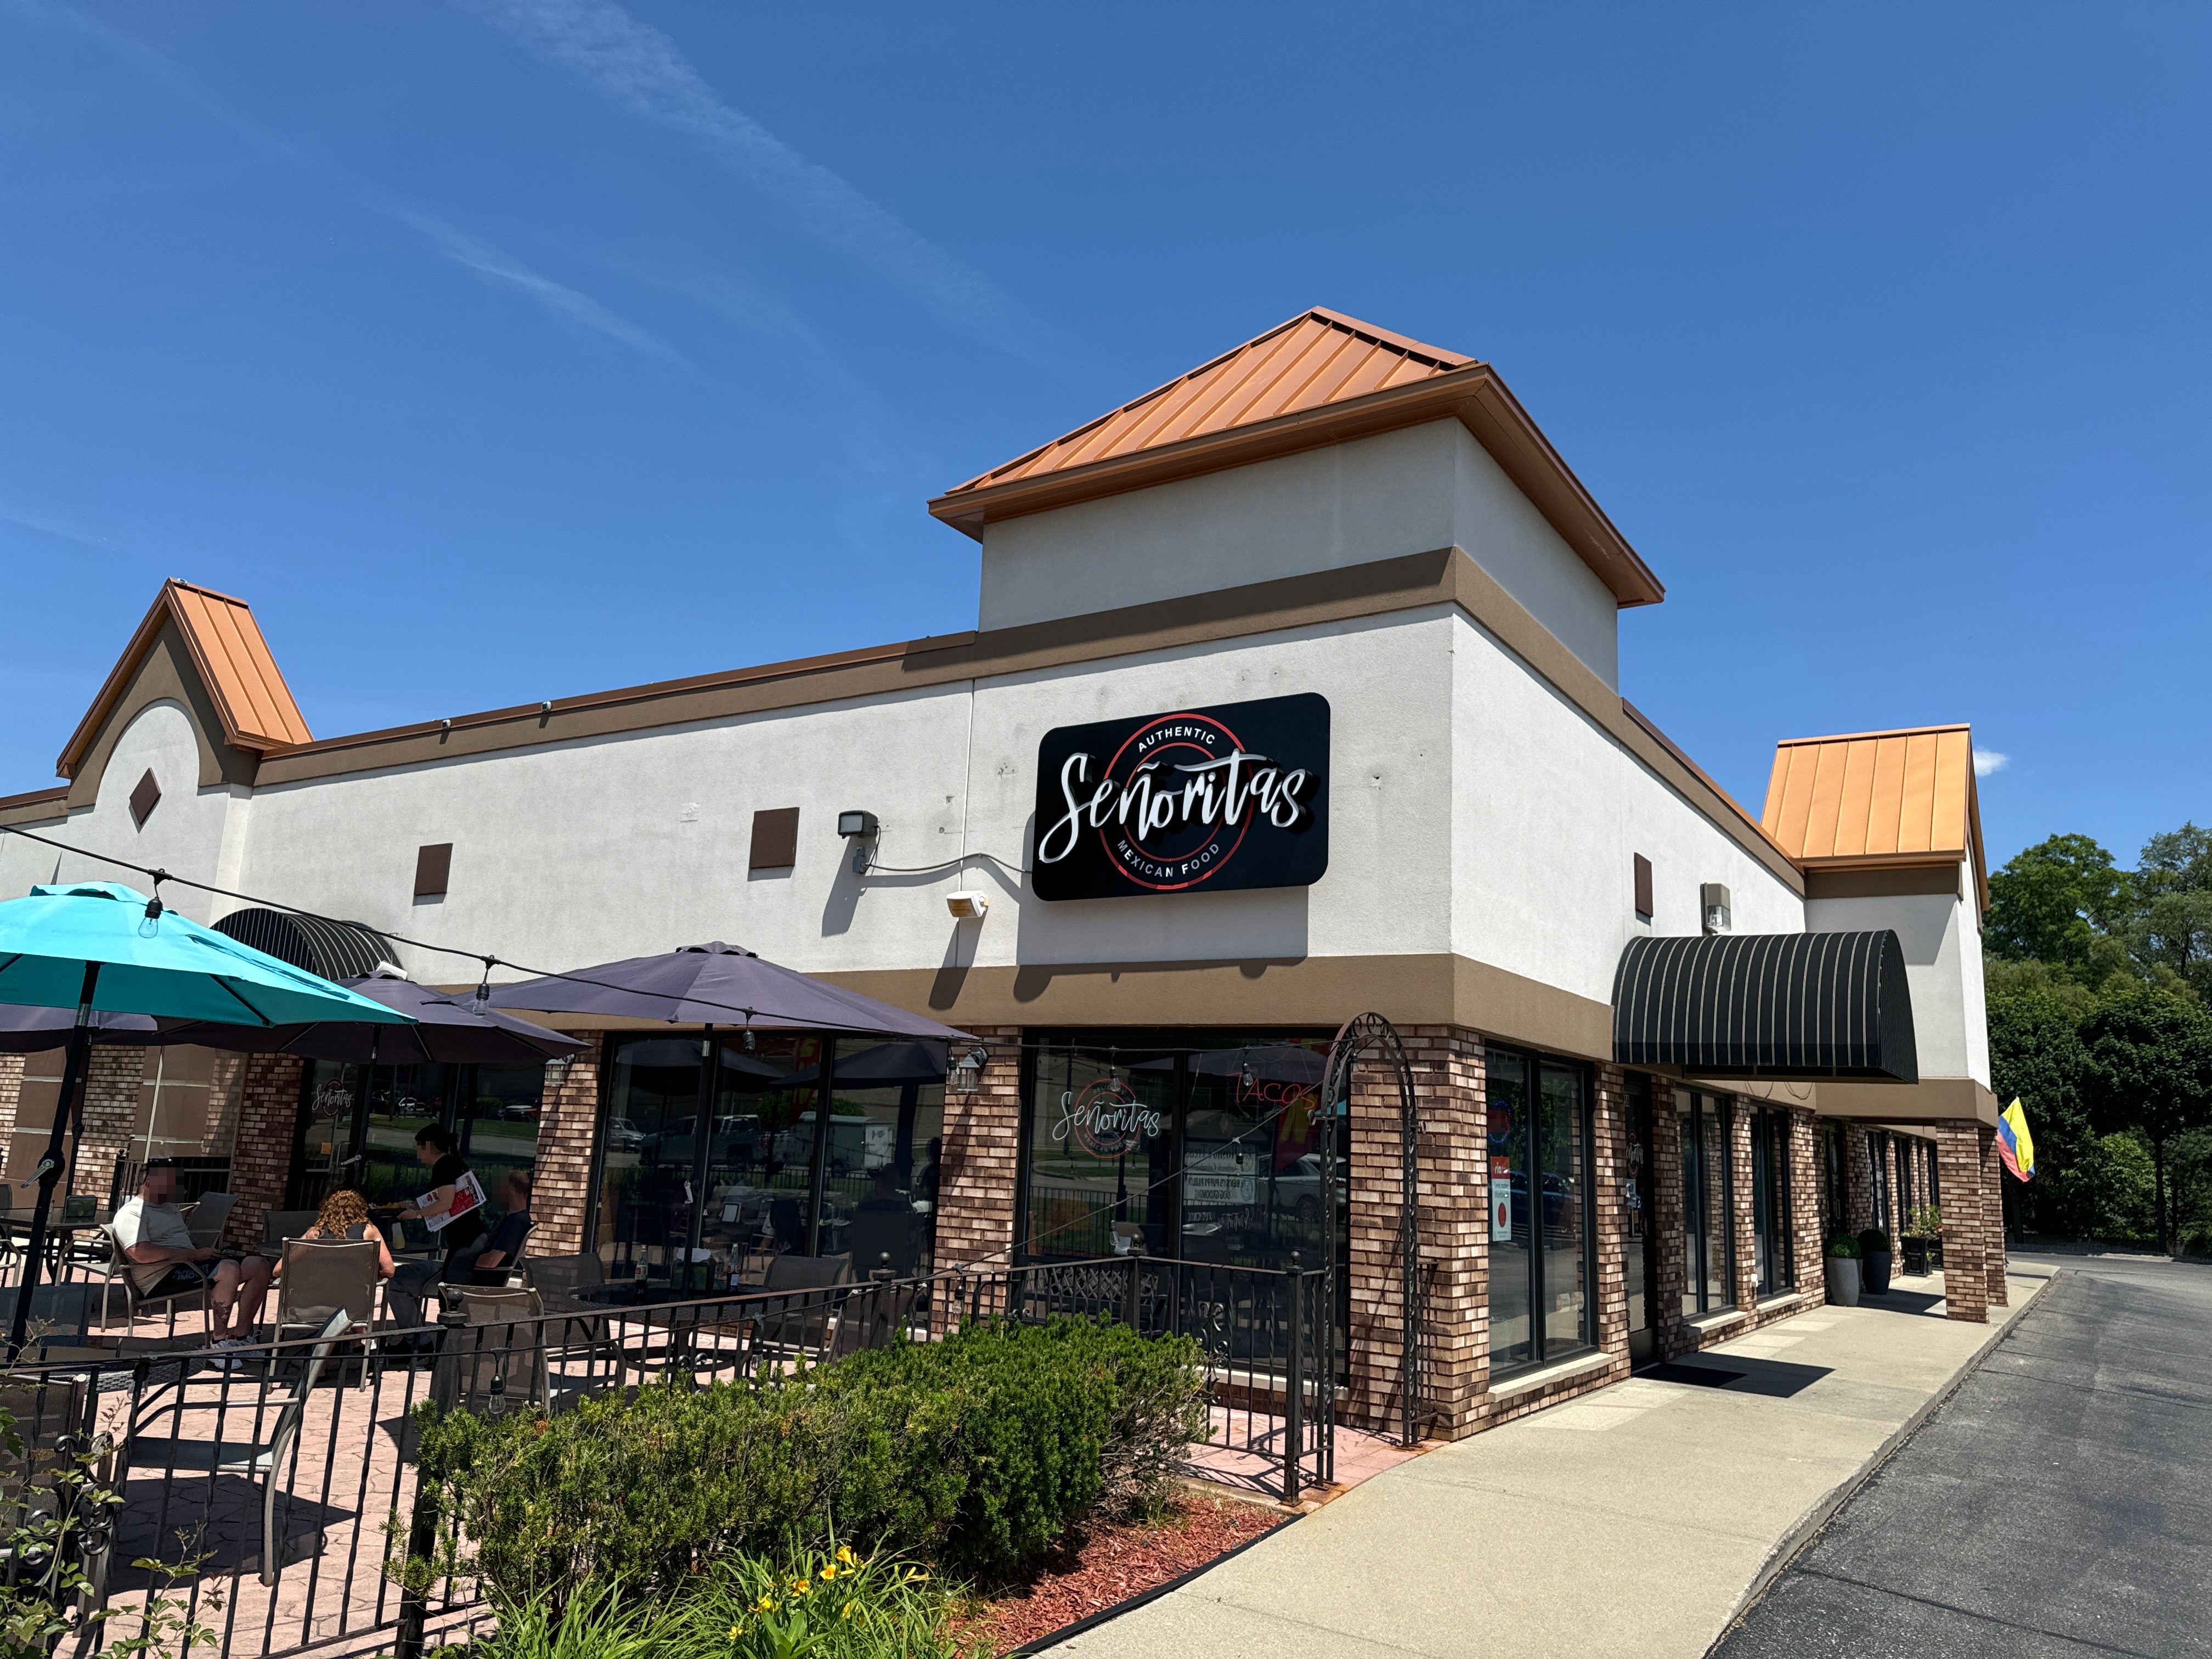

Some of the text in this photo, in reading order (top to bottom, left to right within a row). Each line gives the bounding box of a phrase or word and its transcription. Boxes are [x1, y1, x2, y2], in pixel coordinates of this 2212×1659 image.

[1138, 726, 1216, 753] AUTHENTIC
[1038, 748, 1308, 864] Señoritas
[1118, 839, 1220, 877] MEXICAN FOOD
[312, 1084, 352, 1110] Señoritas
[1226, 1069, 1314, 1110] TACOS
[1052, 1091, 1160, 1141] Señoritas
